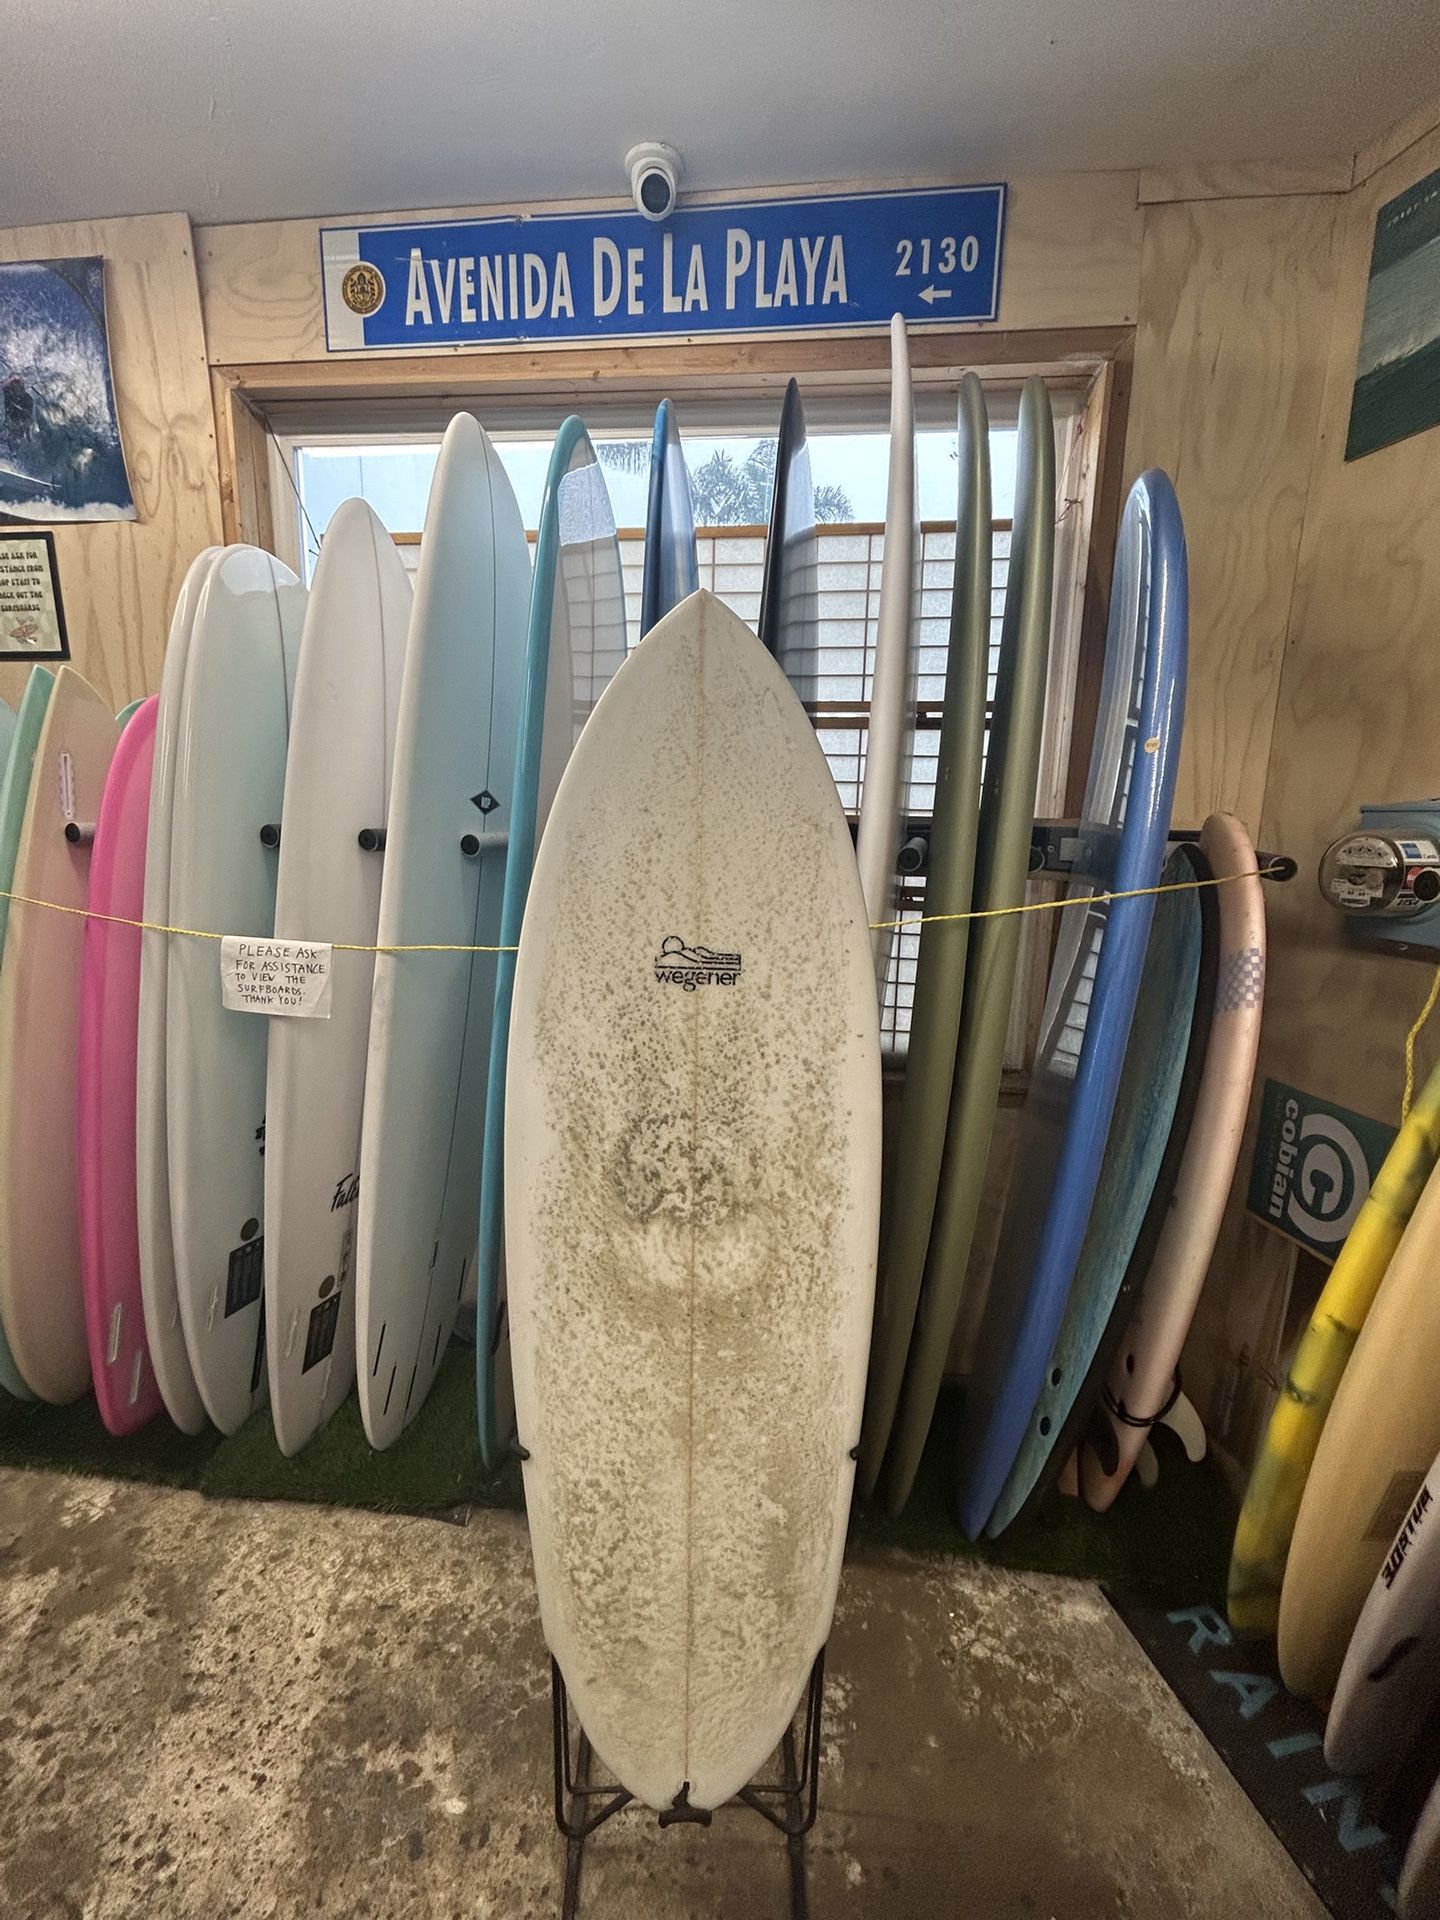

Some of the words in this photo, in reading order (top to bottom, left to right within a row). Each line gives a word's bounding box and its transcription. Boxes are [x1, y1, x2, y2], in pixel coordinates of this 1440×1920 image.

[895, 235, 980, 276] 2130
[239, 943, 291, 958] PLEASE
[235, 959, 255, 970] FOR
[261, 961, 325, 975] ASSISTANCE
[234, 972, 246, 982] TO
[252, 972, 276, 982] VIEW
[285, 975, 306, 985] THE
[655, 970, 741, 993] wegener
[279, 994, 303, 1006] YOU!
[1269, 1099, 1299, 1218] cobian
